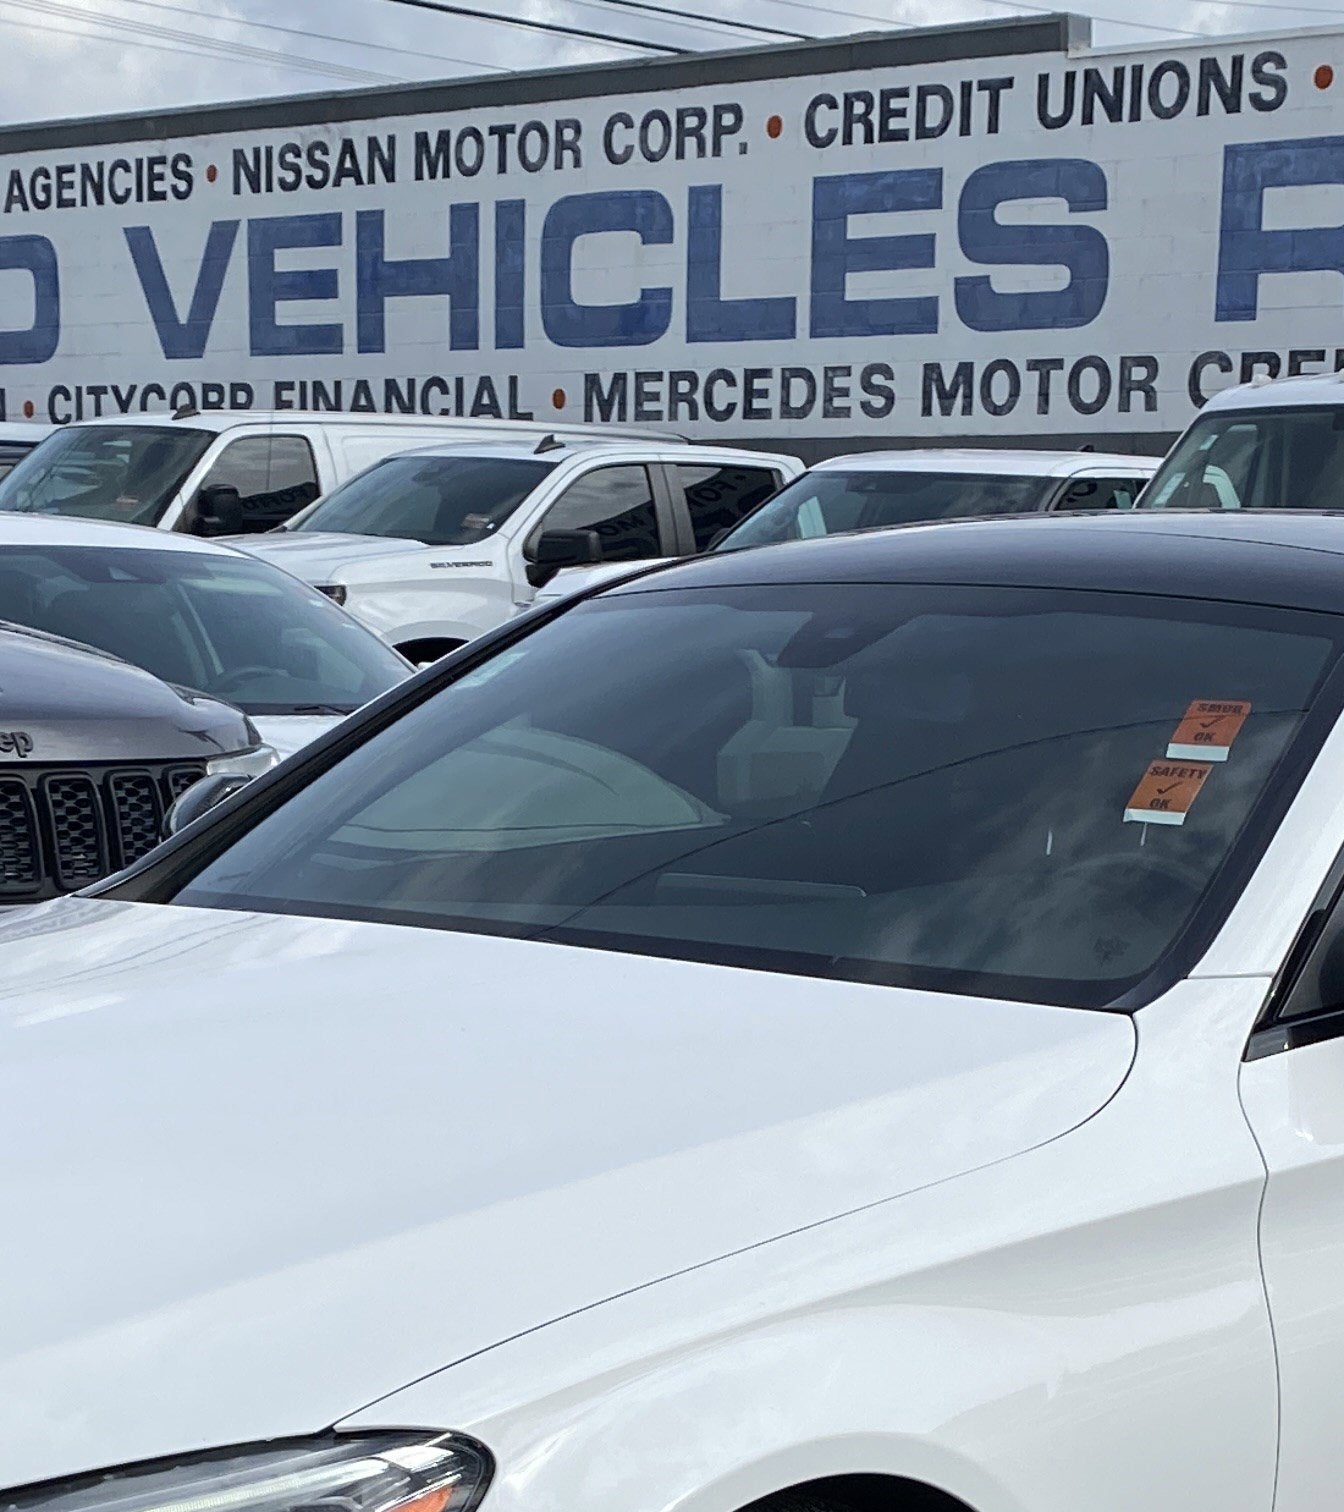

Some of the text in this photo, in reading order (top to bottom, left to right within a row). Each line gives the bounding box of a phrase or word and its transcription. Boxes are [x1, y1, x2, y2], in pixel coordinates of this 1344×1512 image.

[3, 152, 194, 214] AGENCIES
[232, 134, 396, 195] NISSAN
[414, 118, 582, 182] MOTOR
[603, 102, 749, 164] CORP.
[804, 76, 1016, 149] CREDIT
[1036, 51, 1289, 130] UNIONS
[122, 157, 1110, 360] VEHICLES
[274, 375, 533, 420] FINANCIAL
[584, 361, 896, 422] MERCEDES
[920, 355, 1159, 418] MOTOR
[1149, 765, 1208, 780] SAFETY
[1149, 797, 1173, 810] OK
